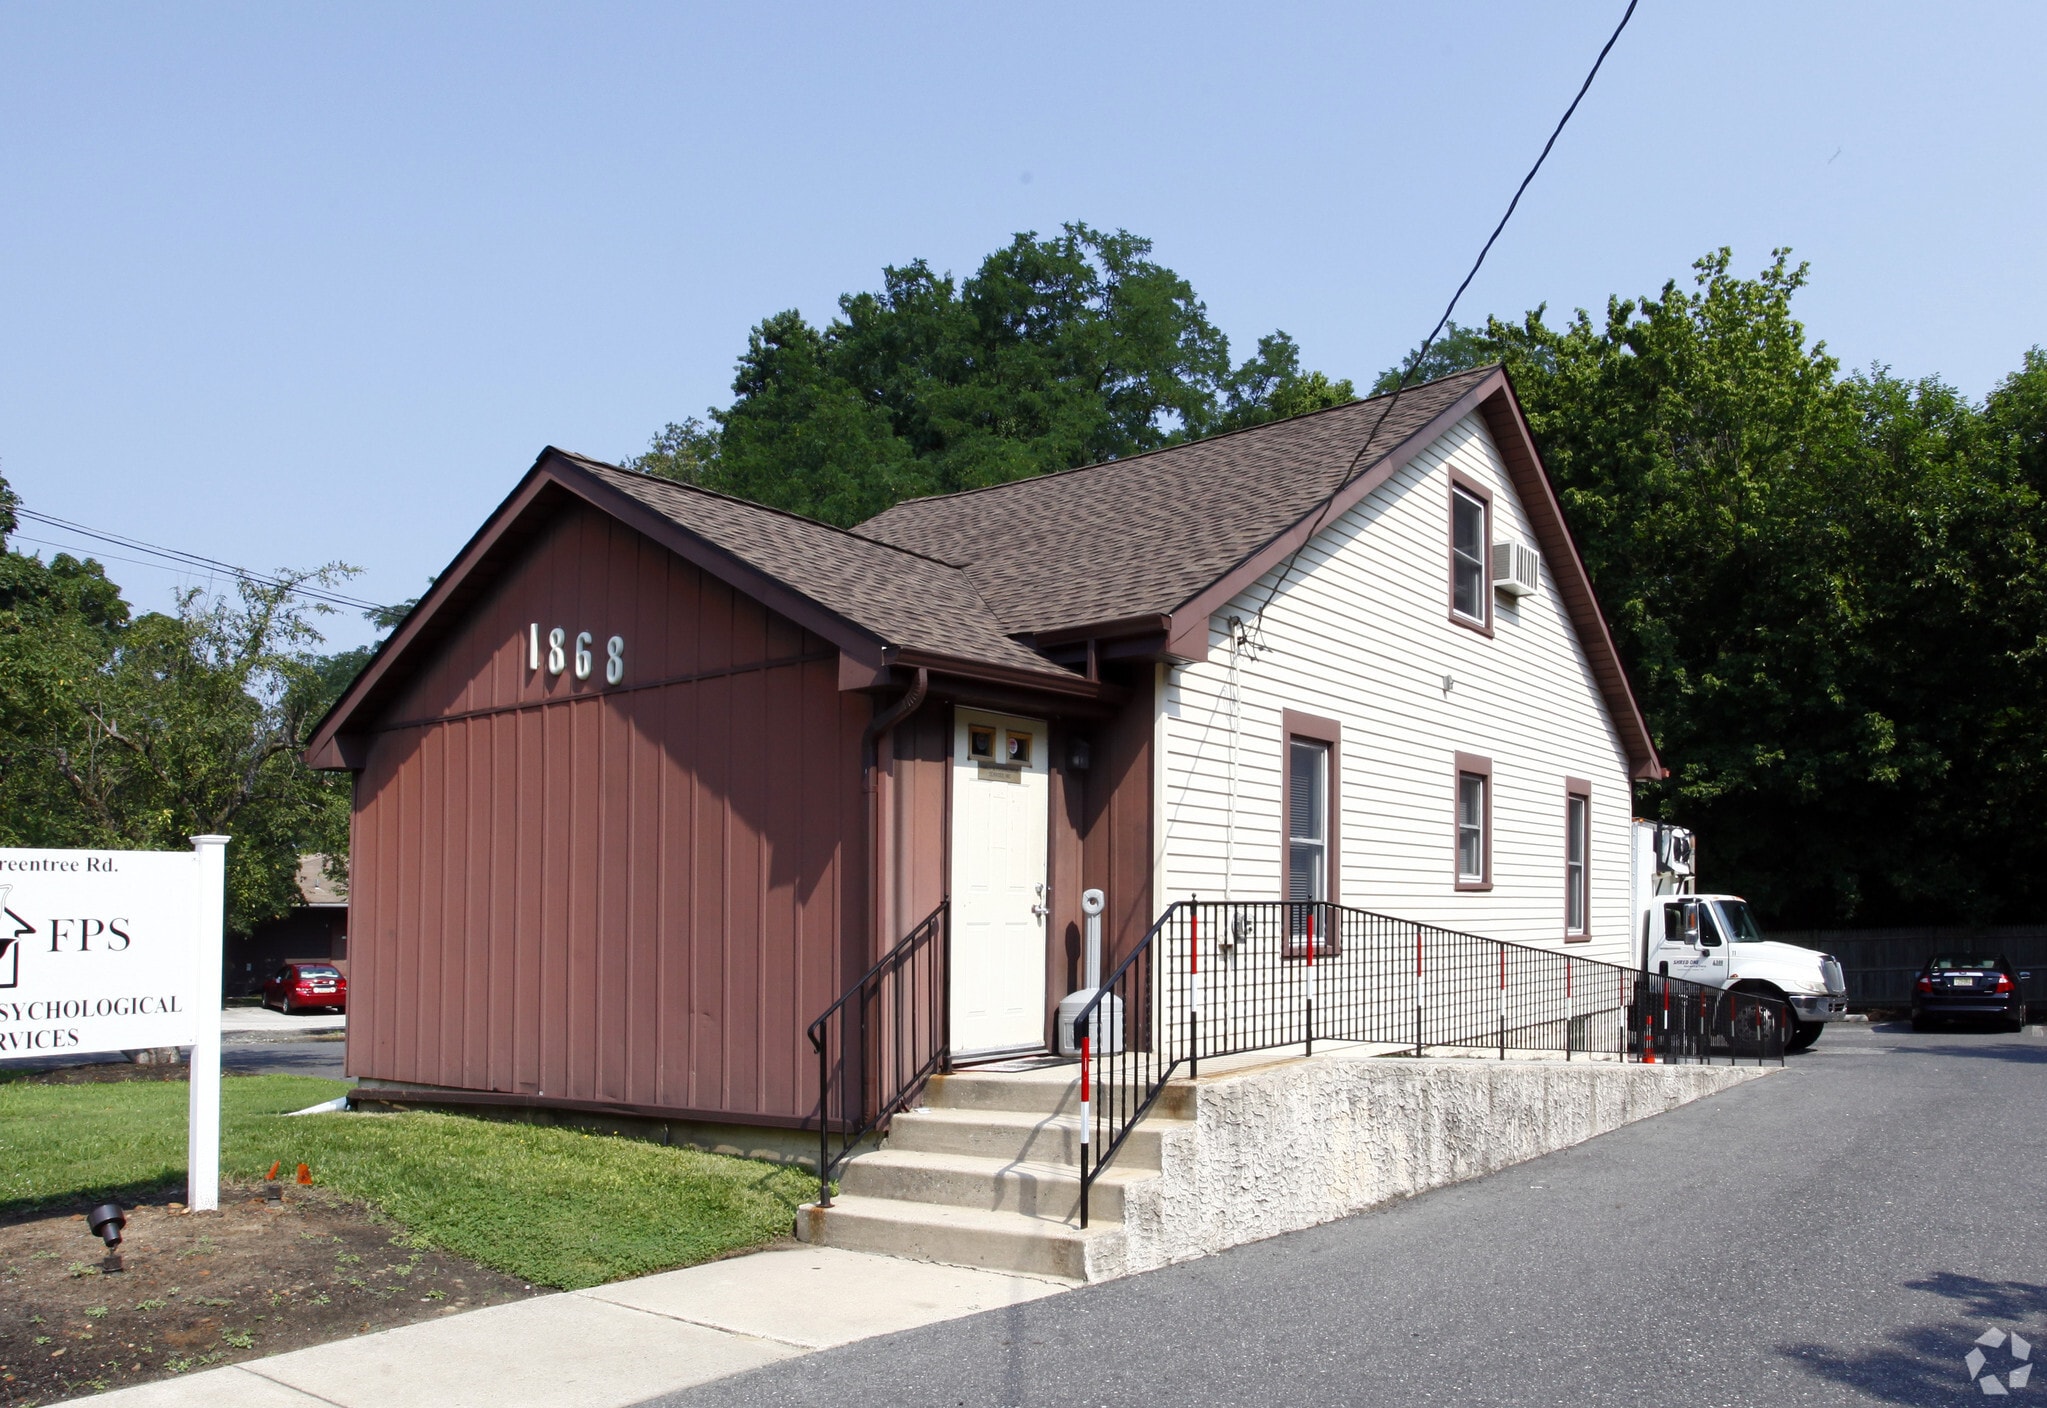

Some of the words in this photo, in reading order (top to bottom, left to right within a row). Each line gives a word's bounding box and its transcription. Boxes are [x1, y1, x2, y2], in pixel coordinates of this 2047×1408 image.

[530, 623, 624, 685] 1868
[86, 857, 119, 873] Rd.
[47, 917, 131, 952] FPS
[0, 995, 183, 1022] SYCHOLOGICAL
